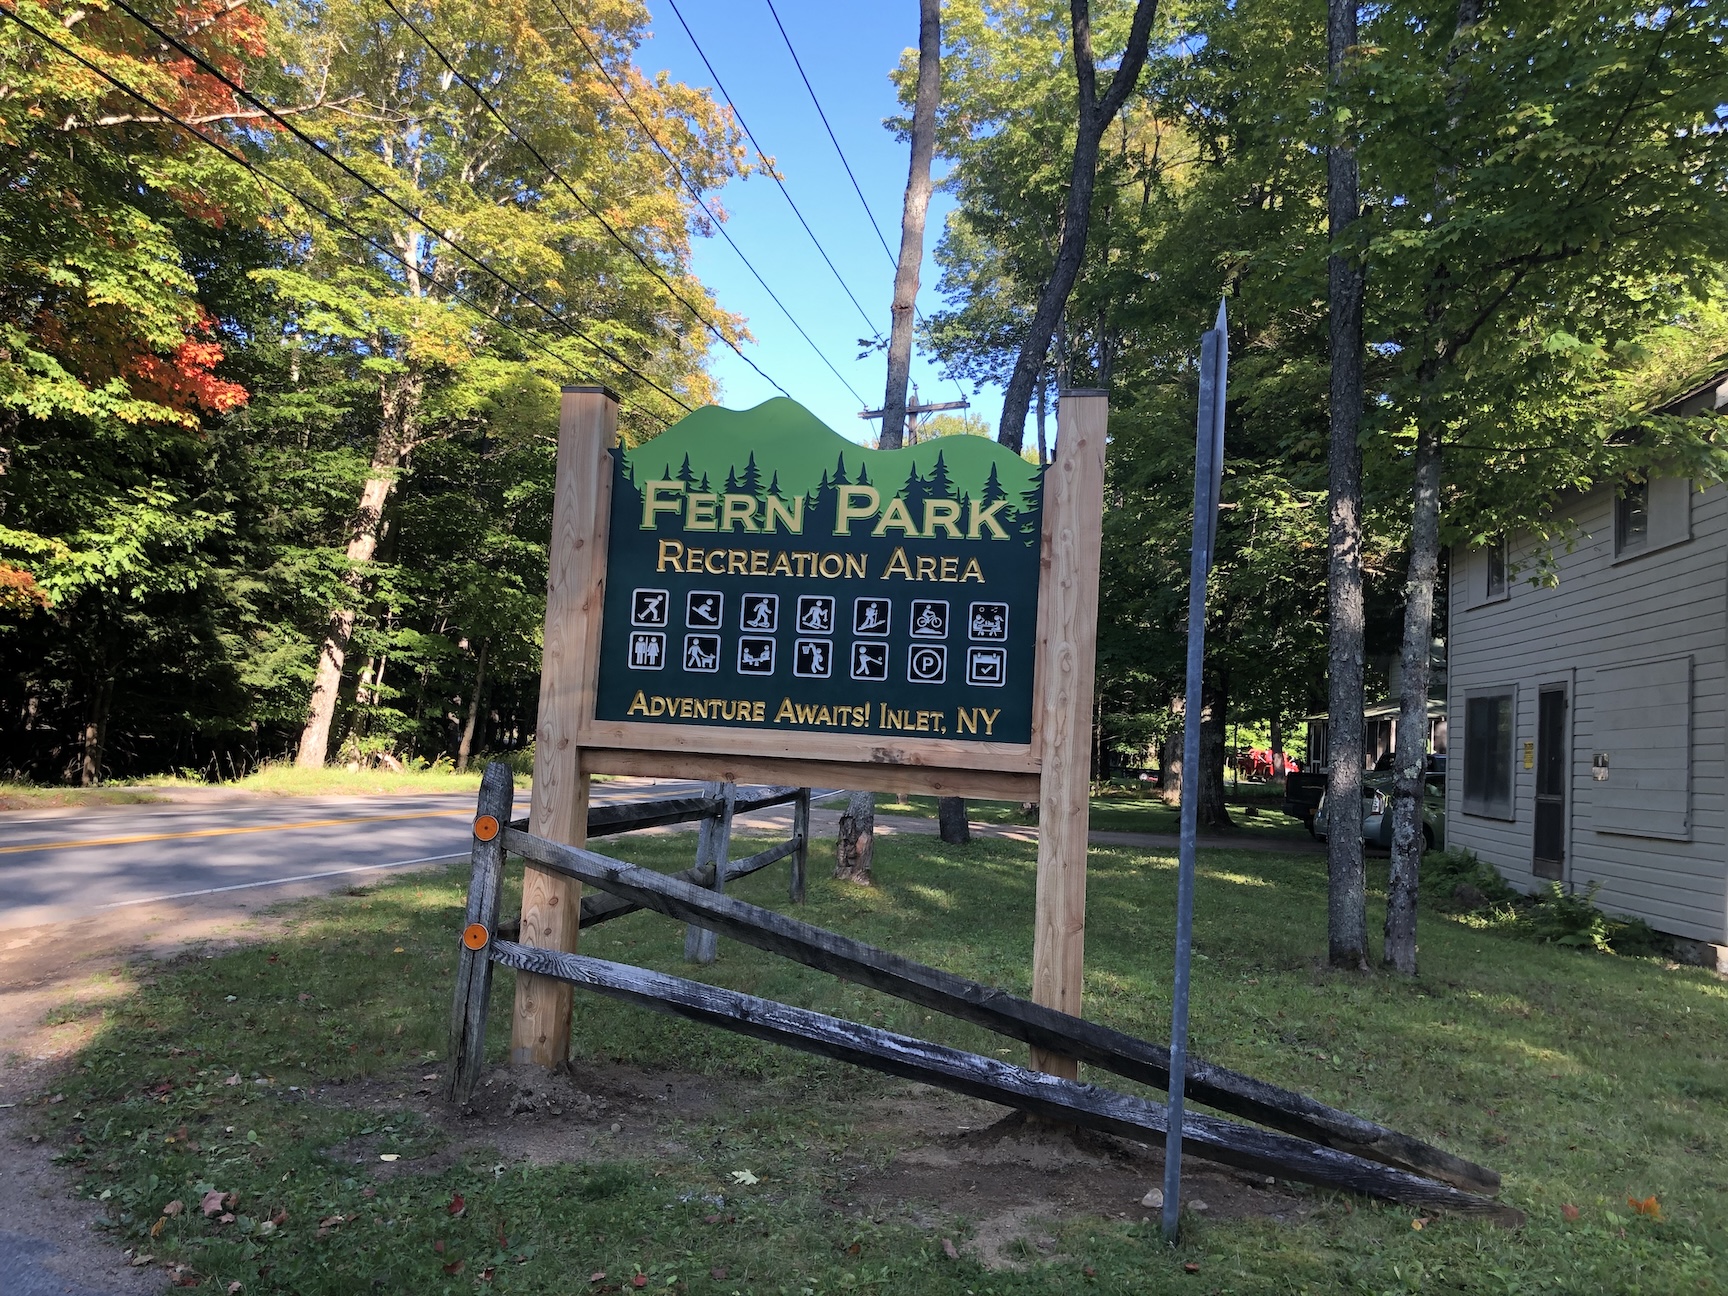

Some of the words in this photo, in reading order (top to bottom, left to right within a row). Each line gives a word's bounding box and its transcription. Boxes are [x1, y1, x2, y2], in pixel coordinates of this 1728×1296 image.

[639, 480, 805, 535] FERN
[833, 484, 1011, 540] PARK
[657, 538, 867, 579] RECREATION
[880, 547, 986, 584] AREA
[922, 655, 934, 670] P
[627, 690, 766, 722] ADVENTURE
[774, 697, 871, 729] AWAITS!
[879, 702, 947, 735] INLET,
[956, 706, 1001, 736] NY
